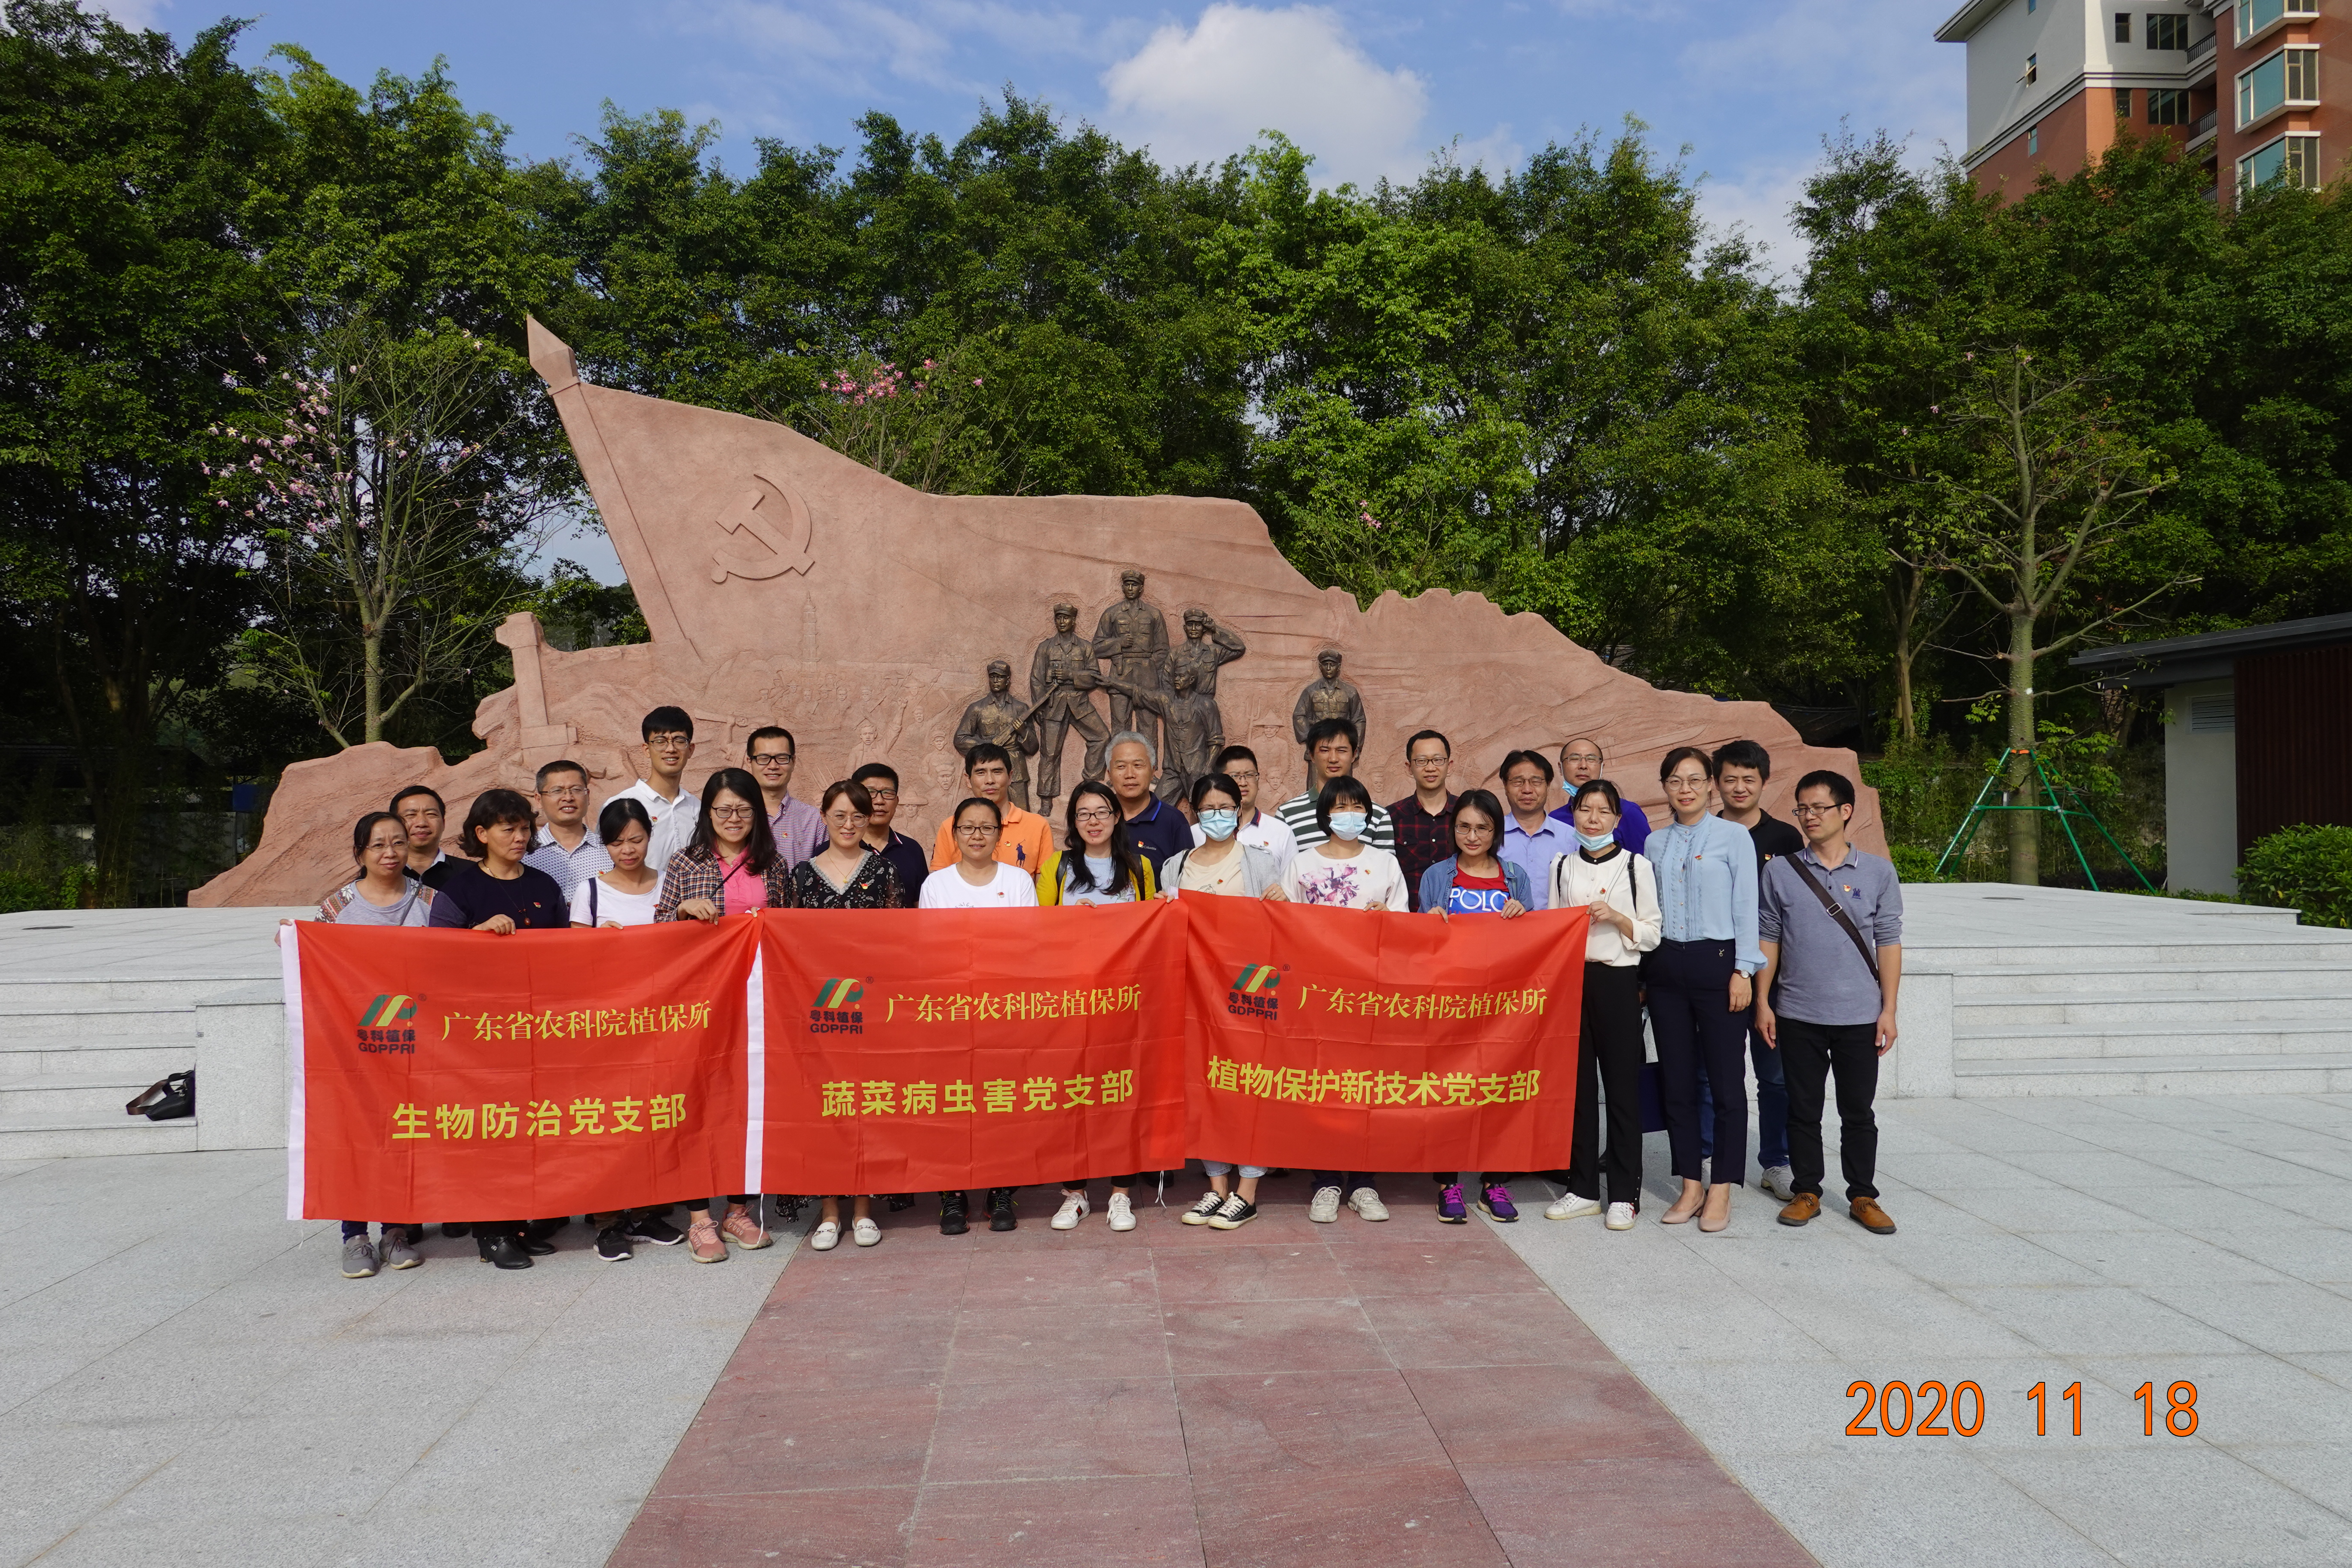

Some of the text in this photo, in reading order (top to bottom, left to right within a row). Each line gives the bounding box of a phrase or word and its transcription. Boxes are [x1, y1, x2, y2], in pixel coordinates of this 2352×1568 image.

[1449, 888, 1508, 912] POLO
[886, 984, 1141, 1023] 广东省农科院植保所
[1228, 1004, 1277, 1021] GDPPRI
[1298, 983, 1547, 1019] 广东省农科院植保所
[442, 1000, 711, 1041] 广东省农科院植保所
[810, 1023, 863, 1034] GDPPRI
[358, 1042, 415, 1054] GDPPRI
[822, 1069, 1133, 1117] 蔬菜病虫害党支部
[1207, 1055, 1540, 1106] 植物保护新技术党支部
[392, 1093, 686, 1139] 生物防治党支部
